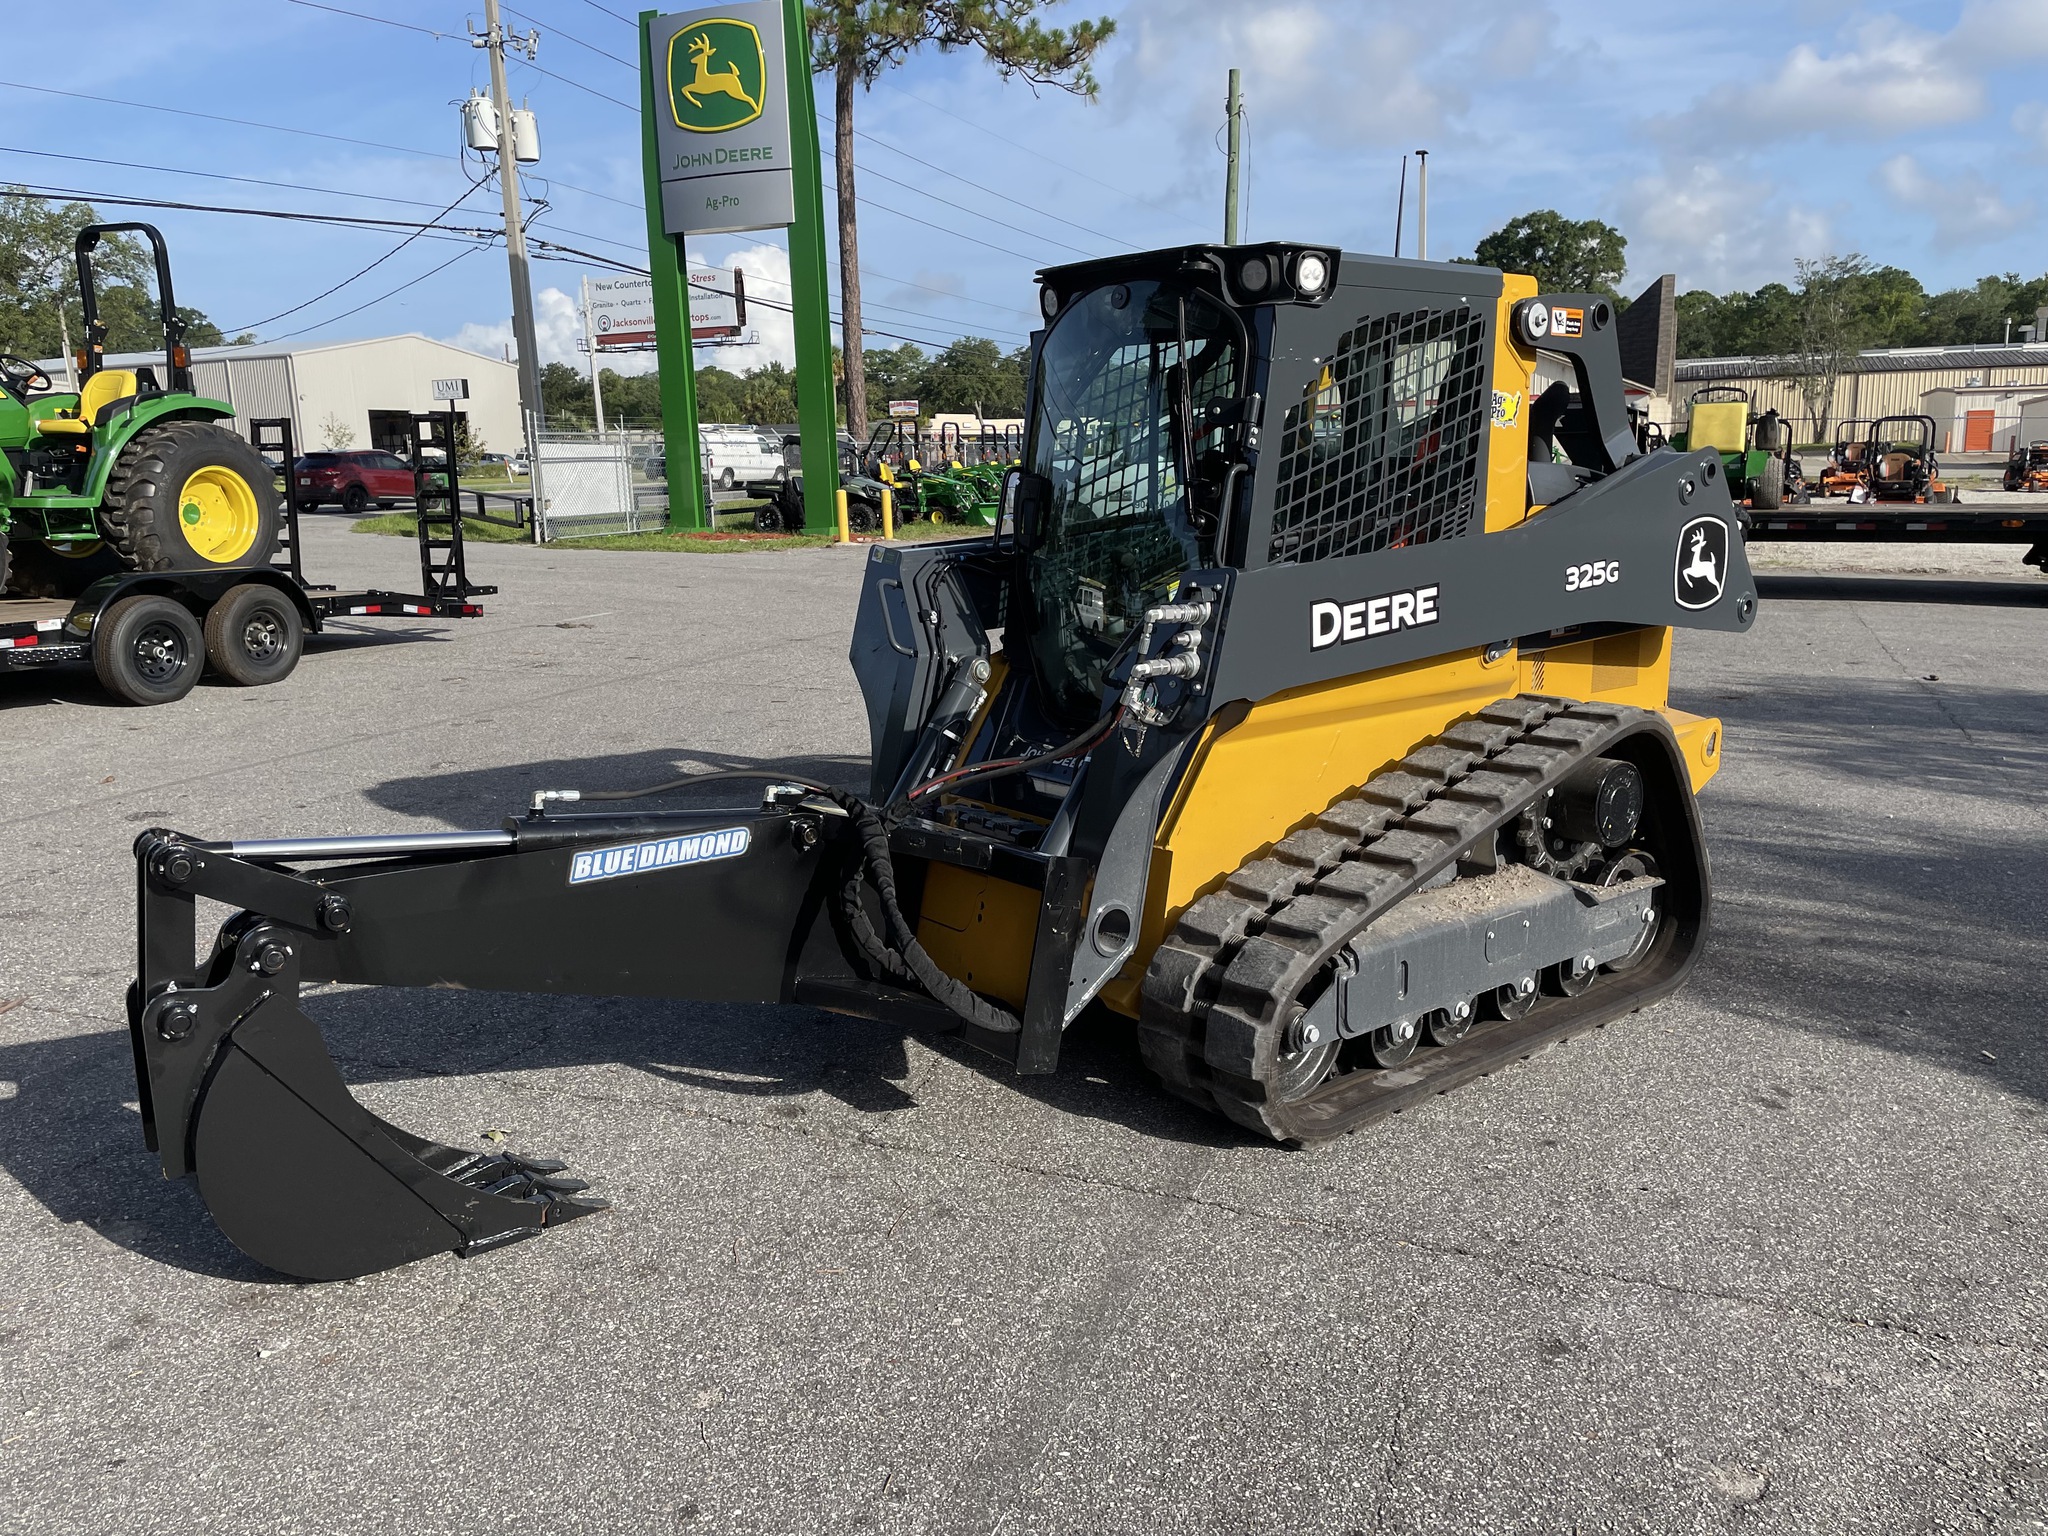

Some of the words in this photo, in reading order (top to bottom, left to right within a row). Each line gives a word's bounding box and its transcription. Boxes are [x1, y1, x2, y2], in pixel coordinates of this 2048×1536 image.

[673, 152, 712, 170] JOHN
[715, 147, 773, 164] DEERE
[705, 195, 740, 211] Ag-Pro
[595, 283, 612, 292] New
[614, 279, 653, 290] Counterto
[691, 274, 716, 283] Stress
[592, 301, 613, 309] Granite
[621, 299, 641, 307] Quartz
[612, 315, 655, 328] Jacksonvill
[437, 381, 458, 392] UMI
[1565, 560, 1620, 592] 325G
[1312, 585, 1439, 649] DEERE
[573, 847, 636, 879] BLUE
[638, 830, 748, 869] DIAMOND
